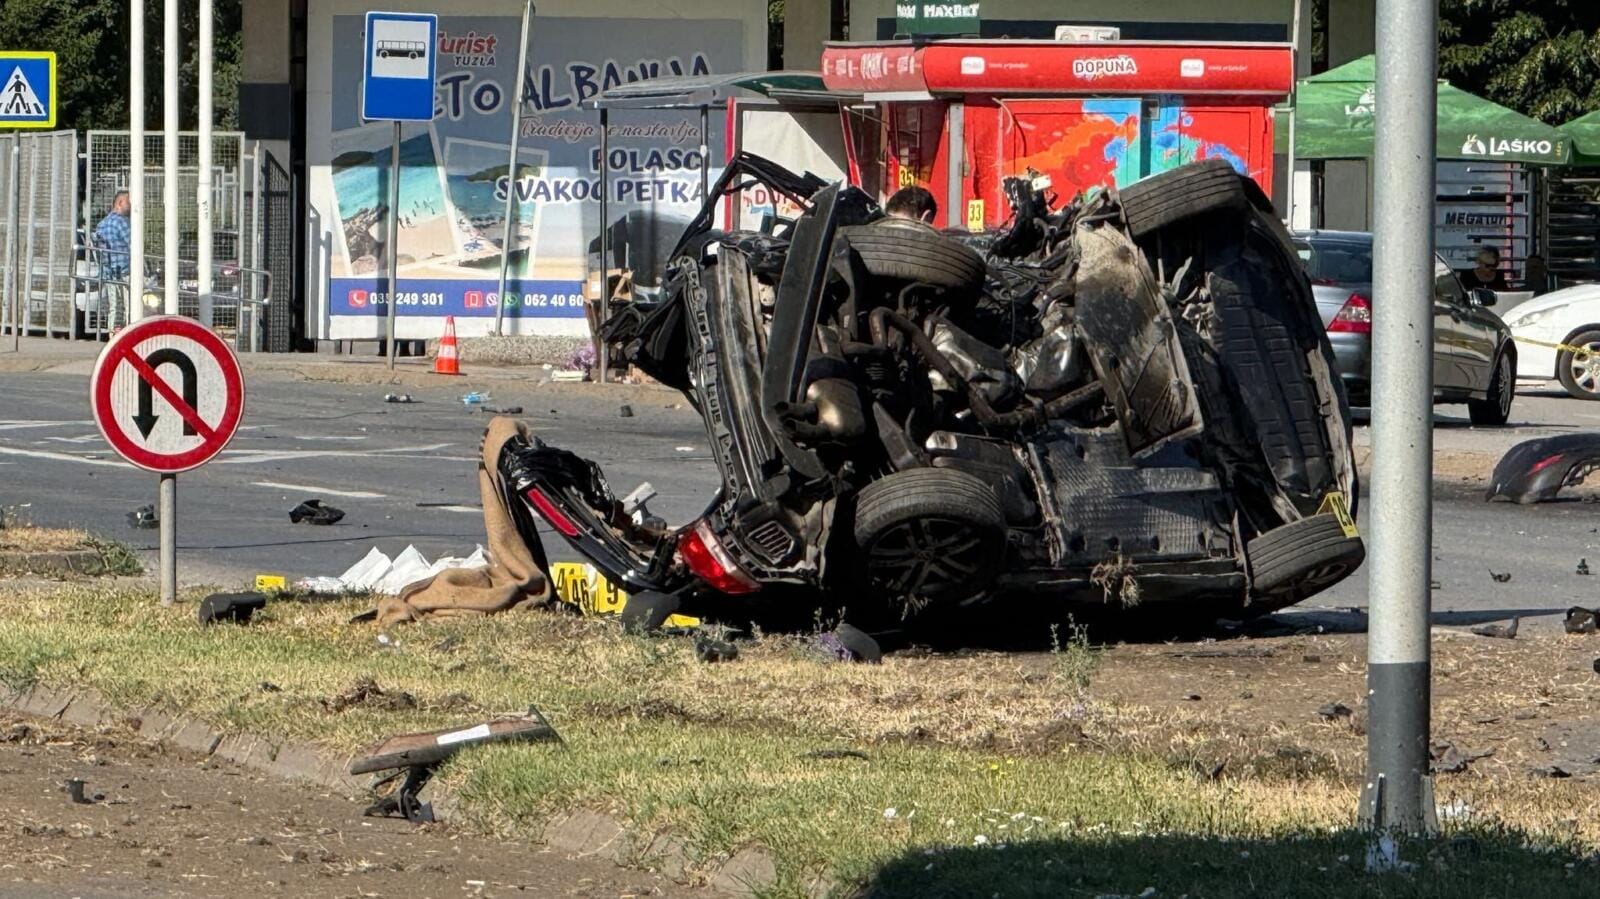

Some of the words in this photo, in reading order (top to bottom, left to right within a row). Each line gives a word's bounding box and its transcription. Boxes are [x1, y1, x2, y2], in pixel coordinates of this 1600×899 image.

[438, 32, 496, 53] urist
[455, 56, 496, 66] TUZLA
[1074, 58, 1136, 74] DOPUNA
[1490, 137, 1552, 155] LAŠKO
[591, 148, 702, 172] POLASC
[969, 203, 981, 221] 33
[395, 292, 418, 305] 249
[421, 292, 443, 305] 301
[524, 294, 547, 306] 062
[550, 294, 566, 306] 40
